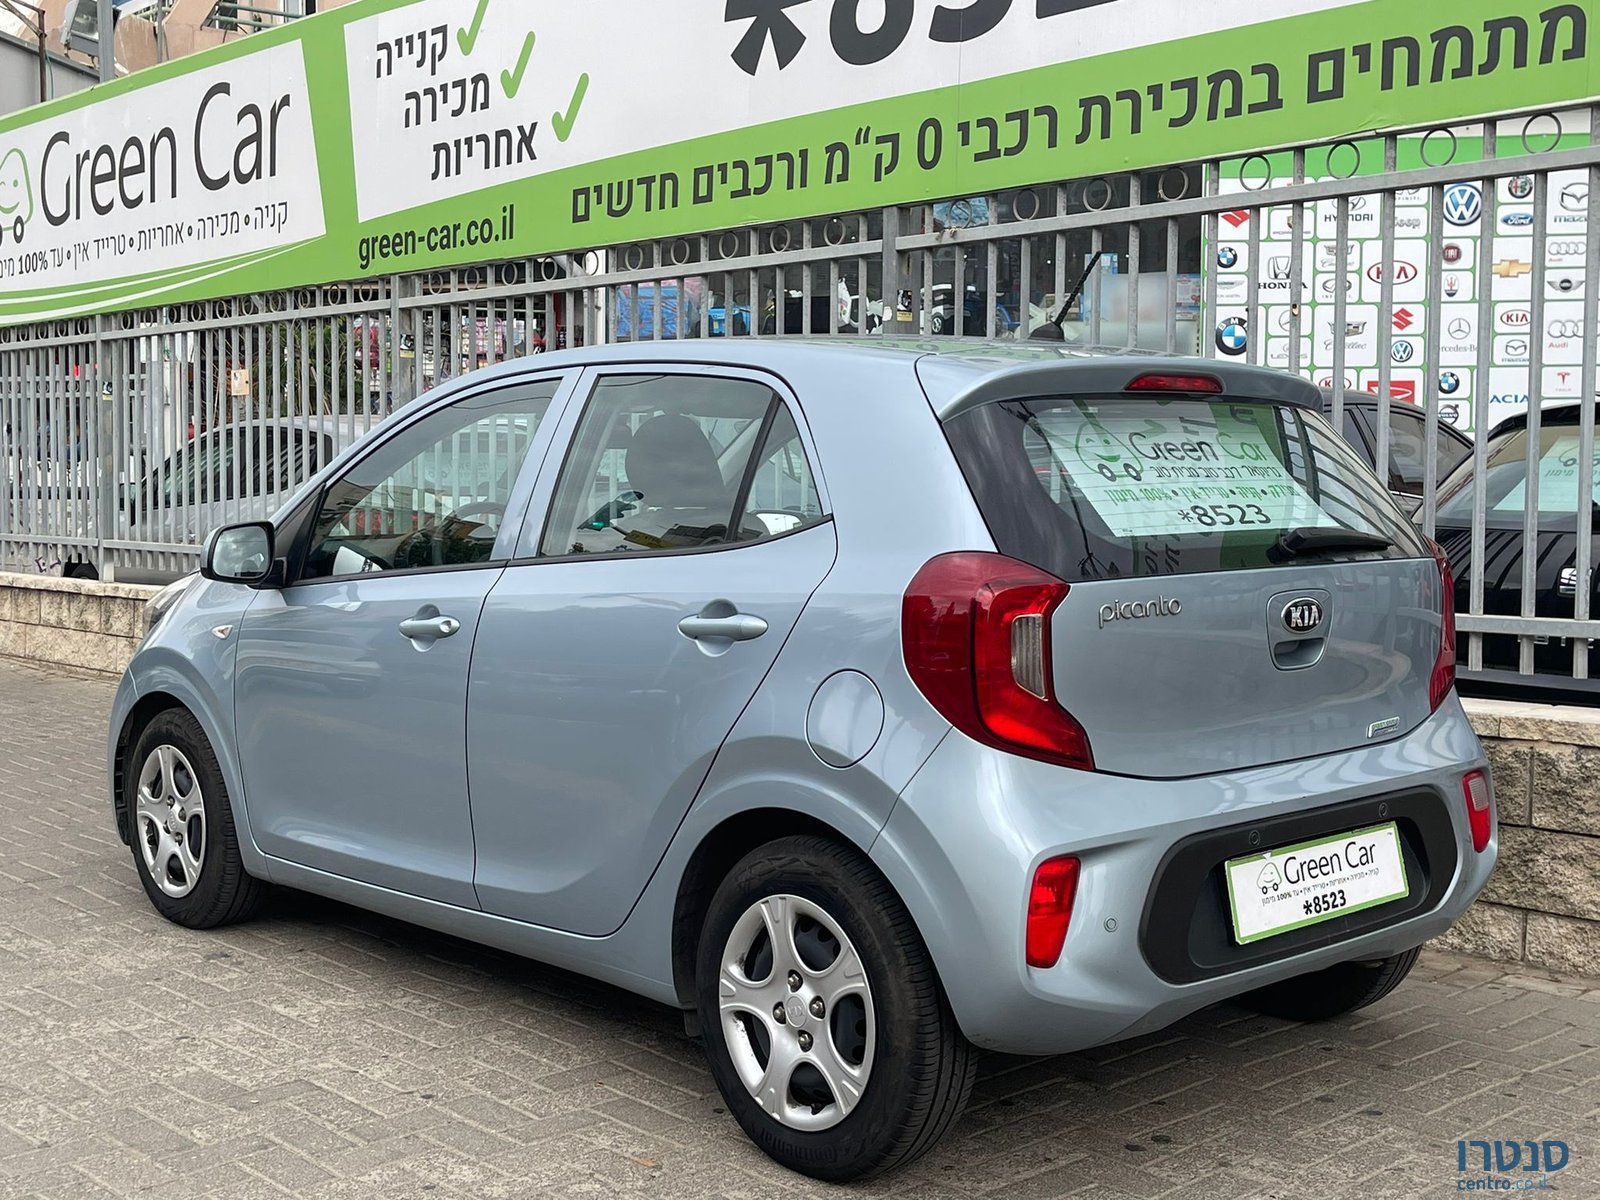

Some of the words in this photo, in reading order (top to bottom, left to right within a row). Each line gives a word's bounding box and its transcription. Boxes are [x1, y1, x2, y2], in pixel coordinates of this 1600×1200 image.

[375, 24, 449, 78] קנייה
[1307, 3, 1587, 105] מתמחים
[403, 72, 490, 128] מכירה
[1075, 62, 1284, 144] במכירת
[916, 117, 943, 170] 0
[957, 105, 1058, 163] רכבי
[40, 126, 178, 227] Green
[194, 81, 291, 192] Car
[430, 121, 539, 181] אחריות
[693, 150, 808, 205] ורכבים
[572, 169, 679, 224] חדשים
[197, 211, 240, 240] מכירה
[254, 201, 288, 233] קניה
[1324, 213, 1373, 222] HYNDAI
[93, 234, 126, 259] טרייד
[137, 222, 185, 251] אחריות
[358, 204, 515, 270] green-car.co.il
[18, 250, 48, 275] 100%
[50, 247, 63, 268] עד
[73, 241, 90, 270] אין
[1506, 313, 1529, 322] KIA
[1548, 341, 1569, 349] Audi
[1490, 394, 1529, 404] ACIA
[1128, 432, 1219, 462] Green
[1215, 431, 1268, 462] Car
[1098, 595, 1182, 630] picanto
[1289, 604, 1320, 628] KIA
[1283, 852, 1342, 884] Green
[1345, 841, 1376, 869] Car
[1276, 890, 1292, 902] 100%
